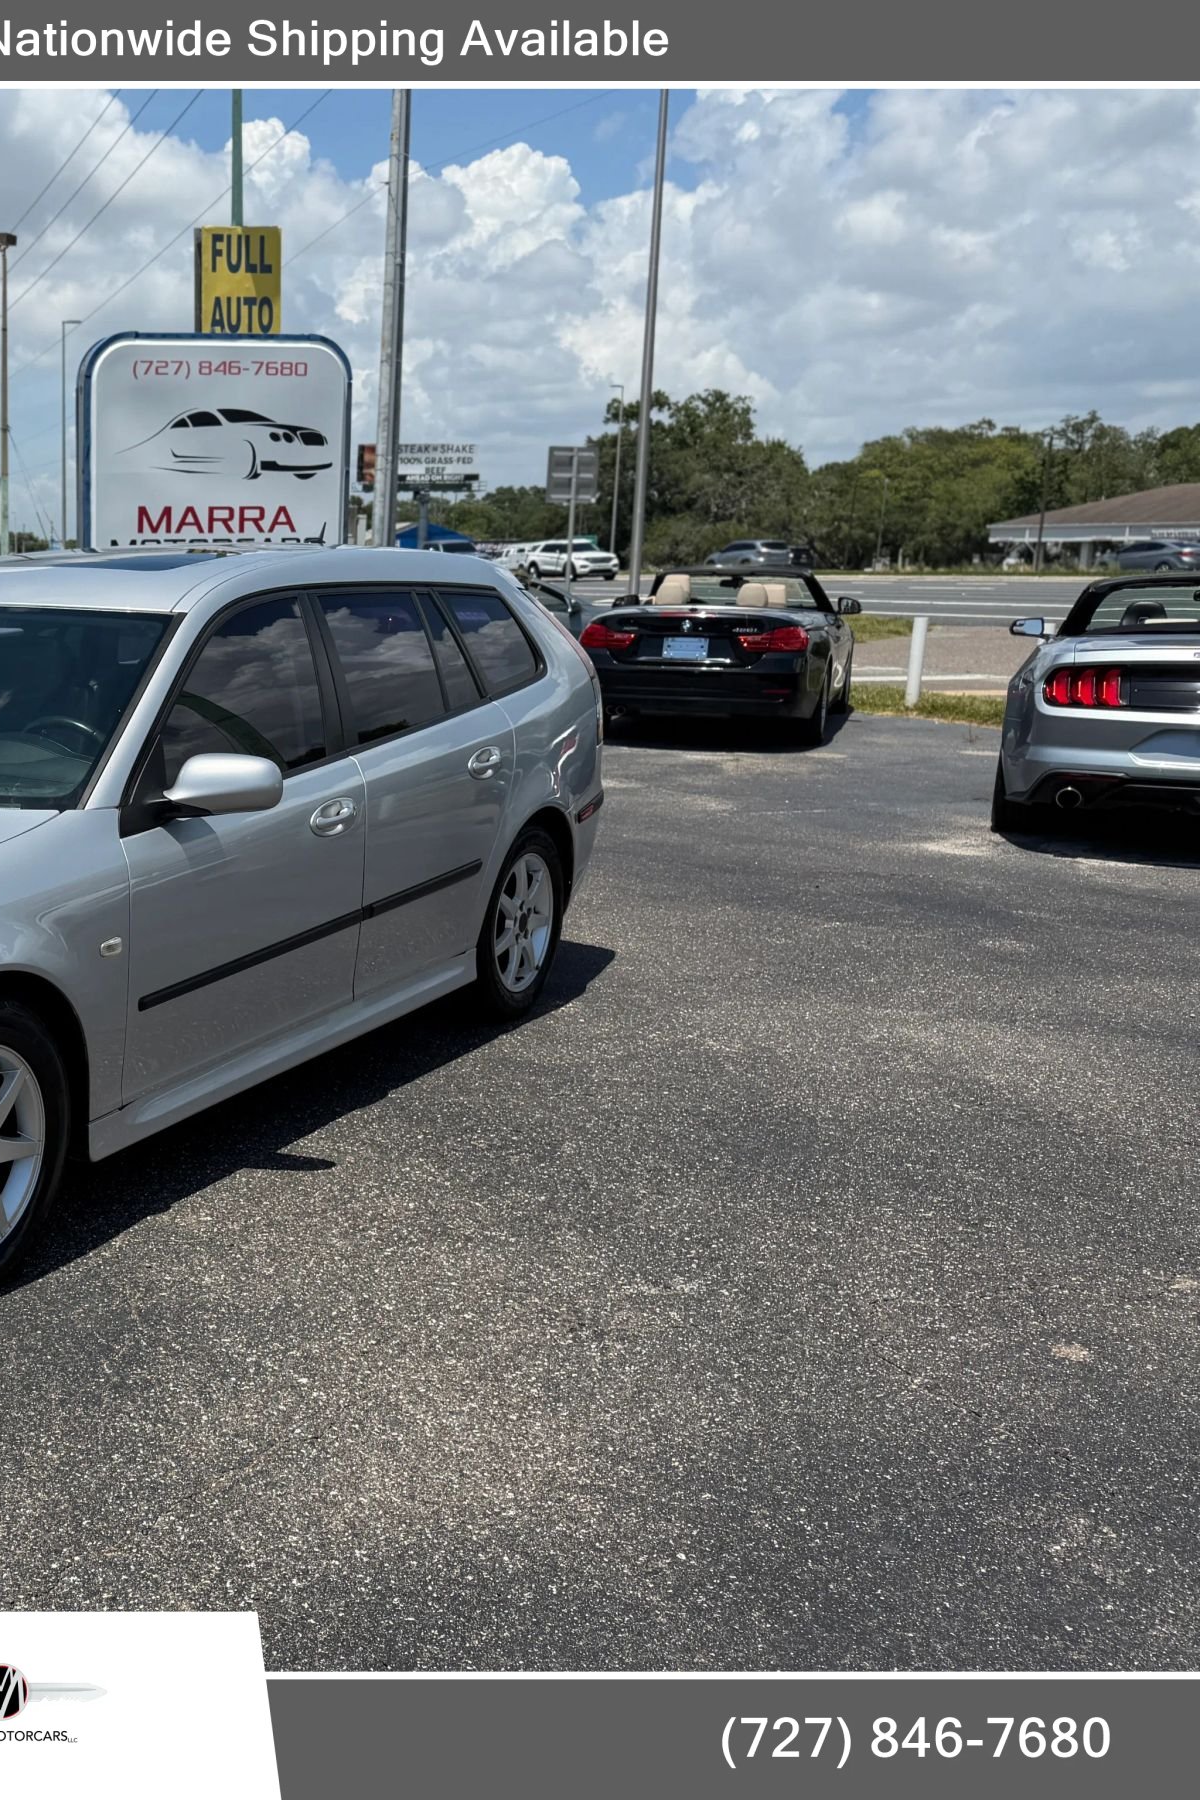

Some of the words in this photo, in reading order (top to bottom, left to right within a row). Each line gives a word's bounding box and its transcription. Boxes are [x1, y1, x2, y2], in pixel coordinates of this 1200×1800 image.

[211, 233, 273, 275] FULL
[210, 296, 274, 334] AUTO
[132, 360, 191, 380] (727)
[198, 360, 308, 378] 846-7680
[398, 444, 430, 454] STEAK
[440, 444, 475, 454] SHAKE
[399, 457, 422, 465] 100%
[424, 456, 474, 465] GRASS-FED
[425, 466, 446, 475] BEEF
[137, 505, 296, 534] MARRA
